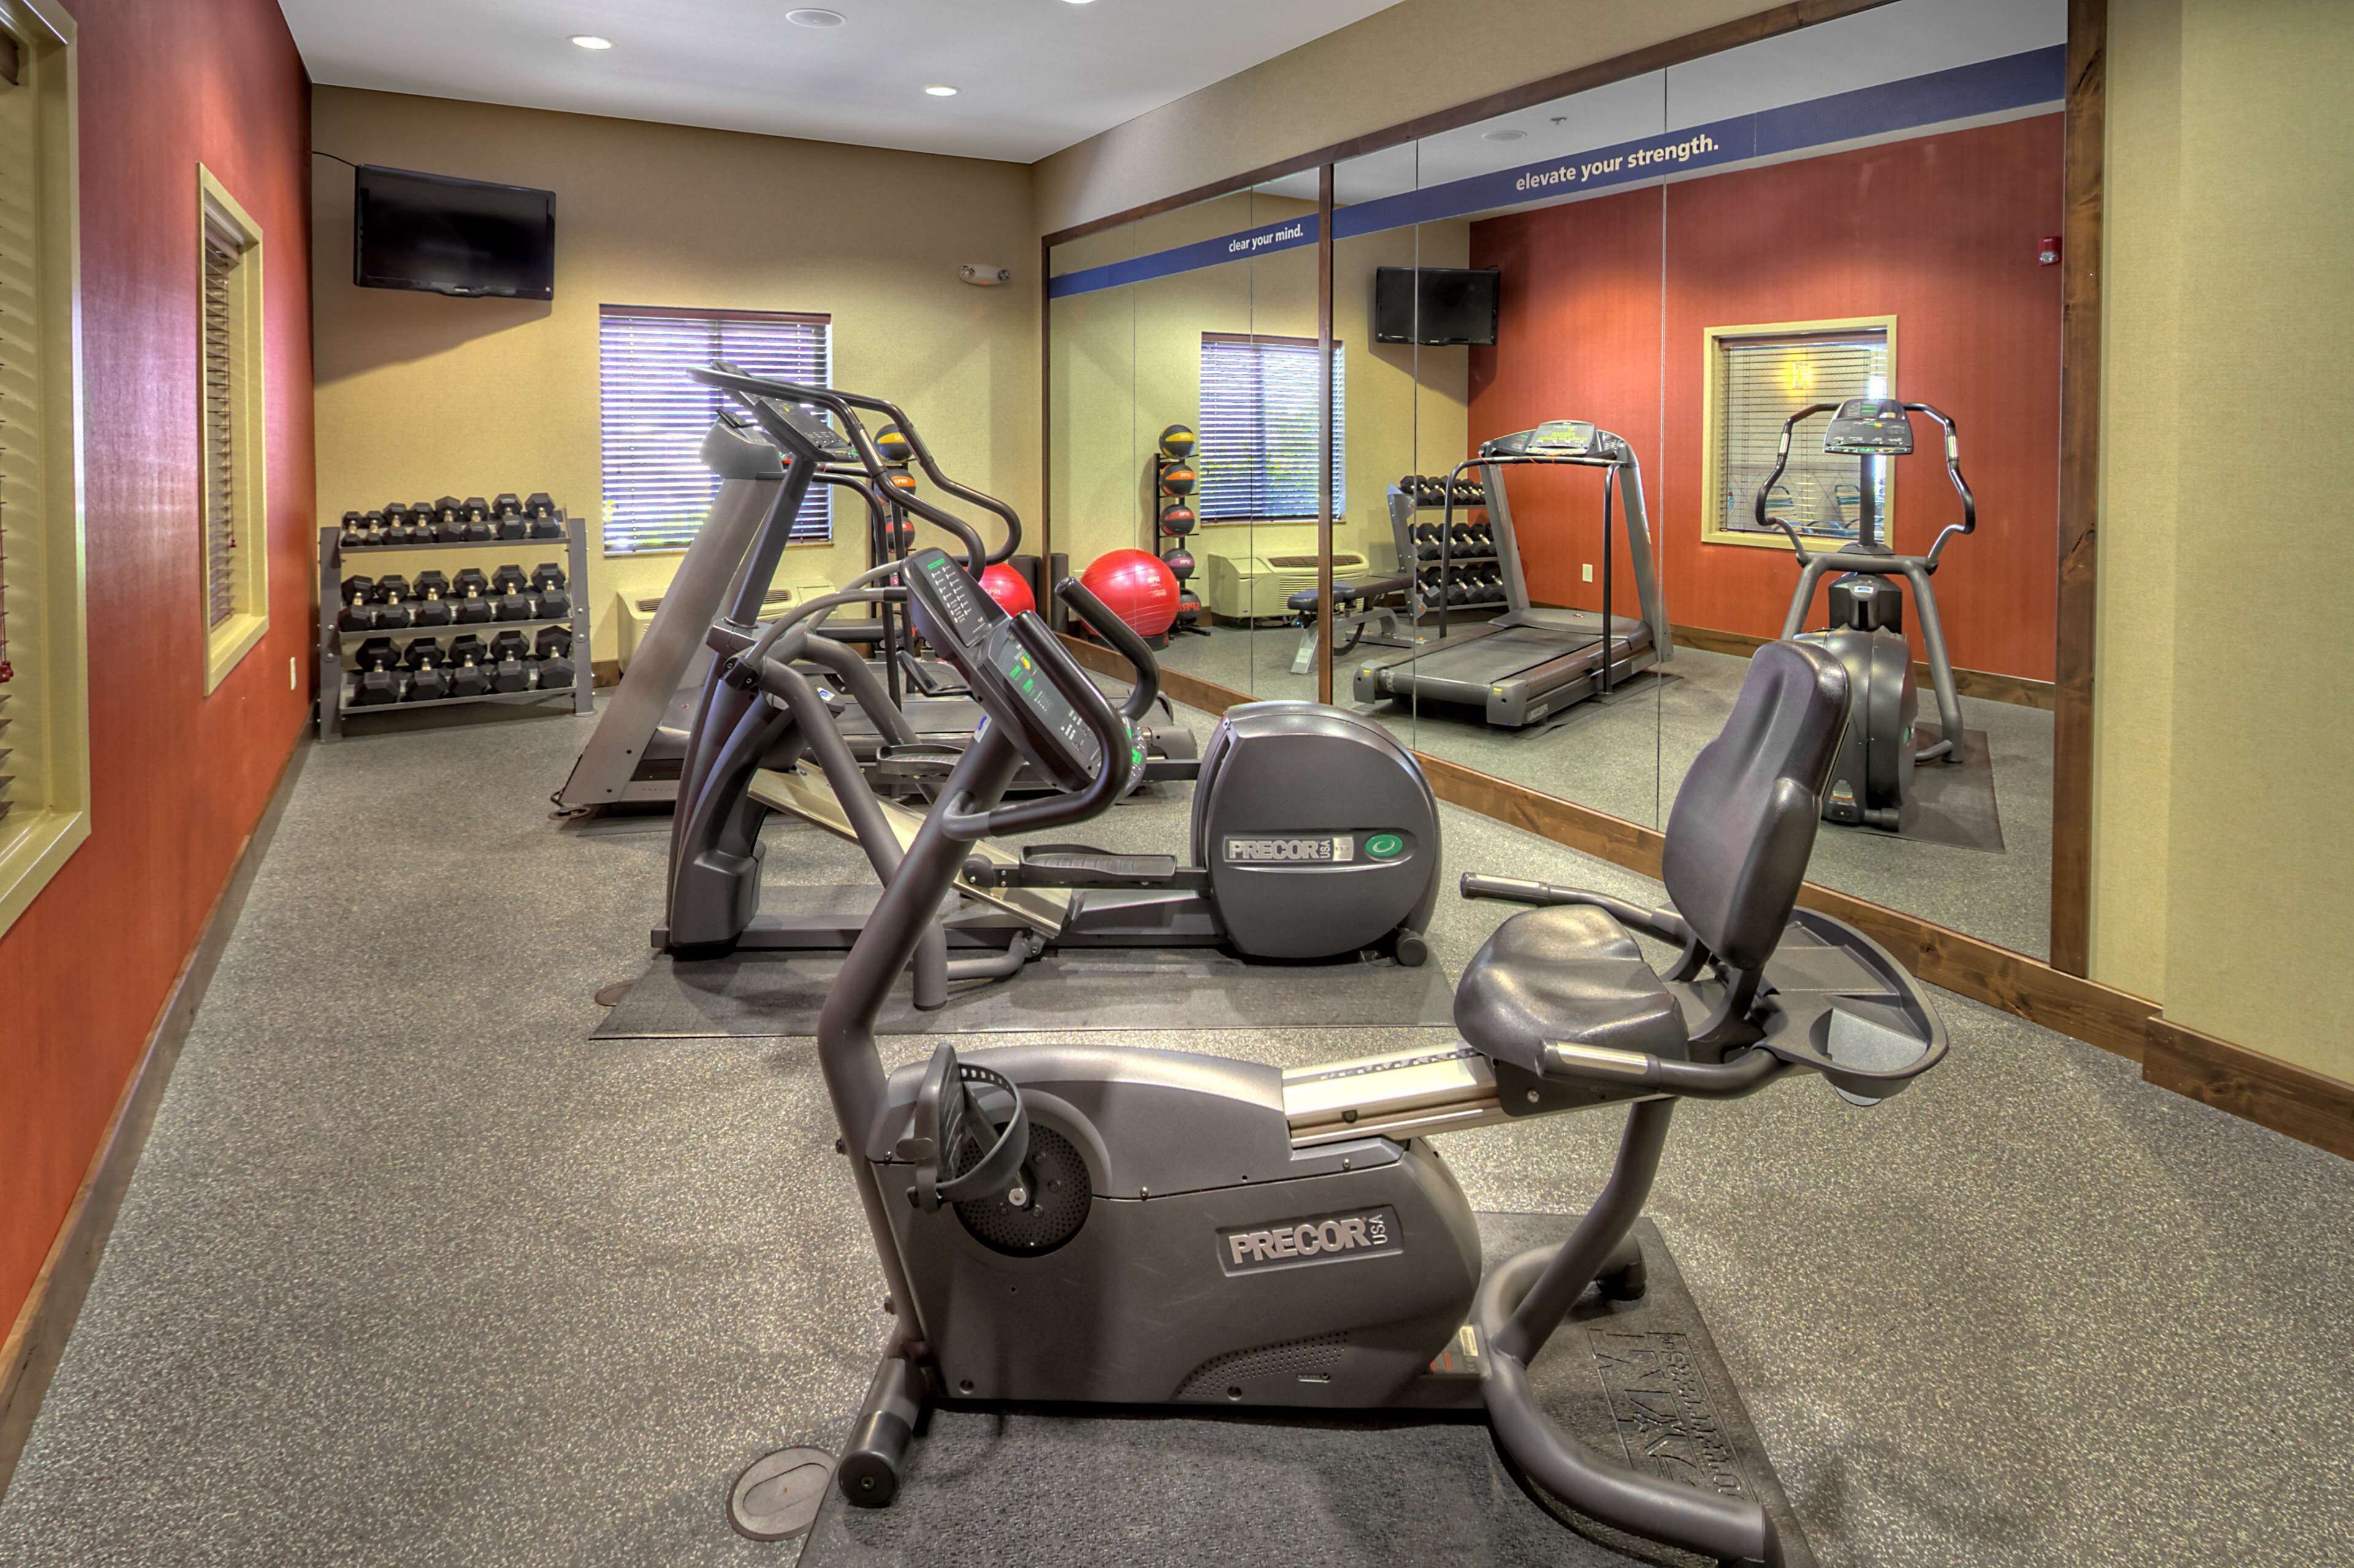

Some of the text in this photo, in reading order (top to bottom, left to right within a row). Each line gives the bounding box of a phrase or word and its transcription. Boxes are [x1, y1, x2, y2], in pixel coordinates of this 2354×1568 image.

[1516, 134, 1719, 191] elevate your strength.
[1229, 223, 1304, 253] clear your mind.
[1228, 839, 1331, 860] PRECOR USA
[1228, 1214, 1388, 1264] PRECOR USA
